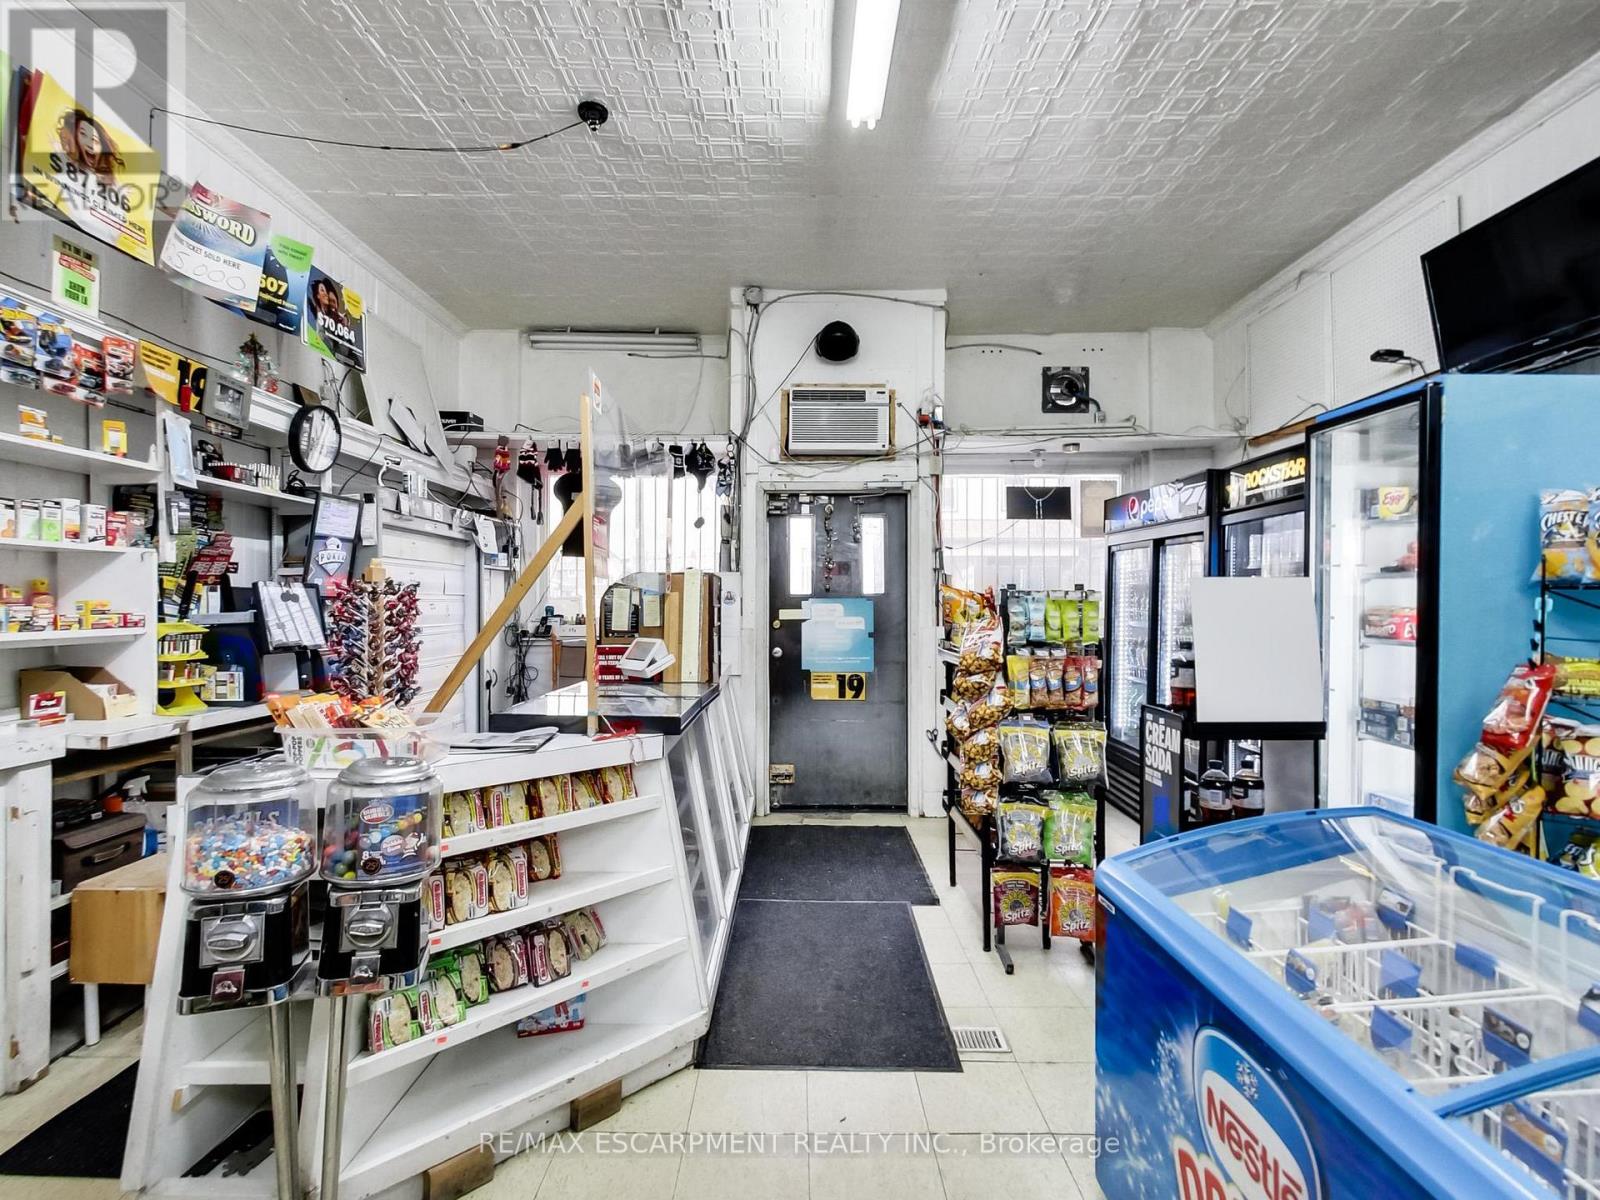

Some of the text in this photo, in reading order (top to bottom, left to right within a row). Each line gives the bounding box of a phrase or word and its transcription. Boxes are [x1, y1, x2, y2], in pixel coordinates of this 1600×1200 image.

[1245, 457, 1306, 489] ROCKSTAR
[836, 673, 865, 699] 19
[1145, 743, 1173, 775] SODA
[1014, 761, 1045, 774] Spitz
[1069, 763, 1098, 777] Spitz
[1011, 838, 1037, 854] Spitz
[1055, 841, 1084, 854] Spitz
[1004, 909, 1032, 922] Spitz
[1062, 919, 1091, 932] Spitz
